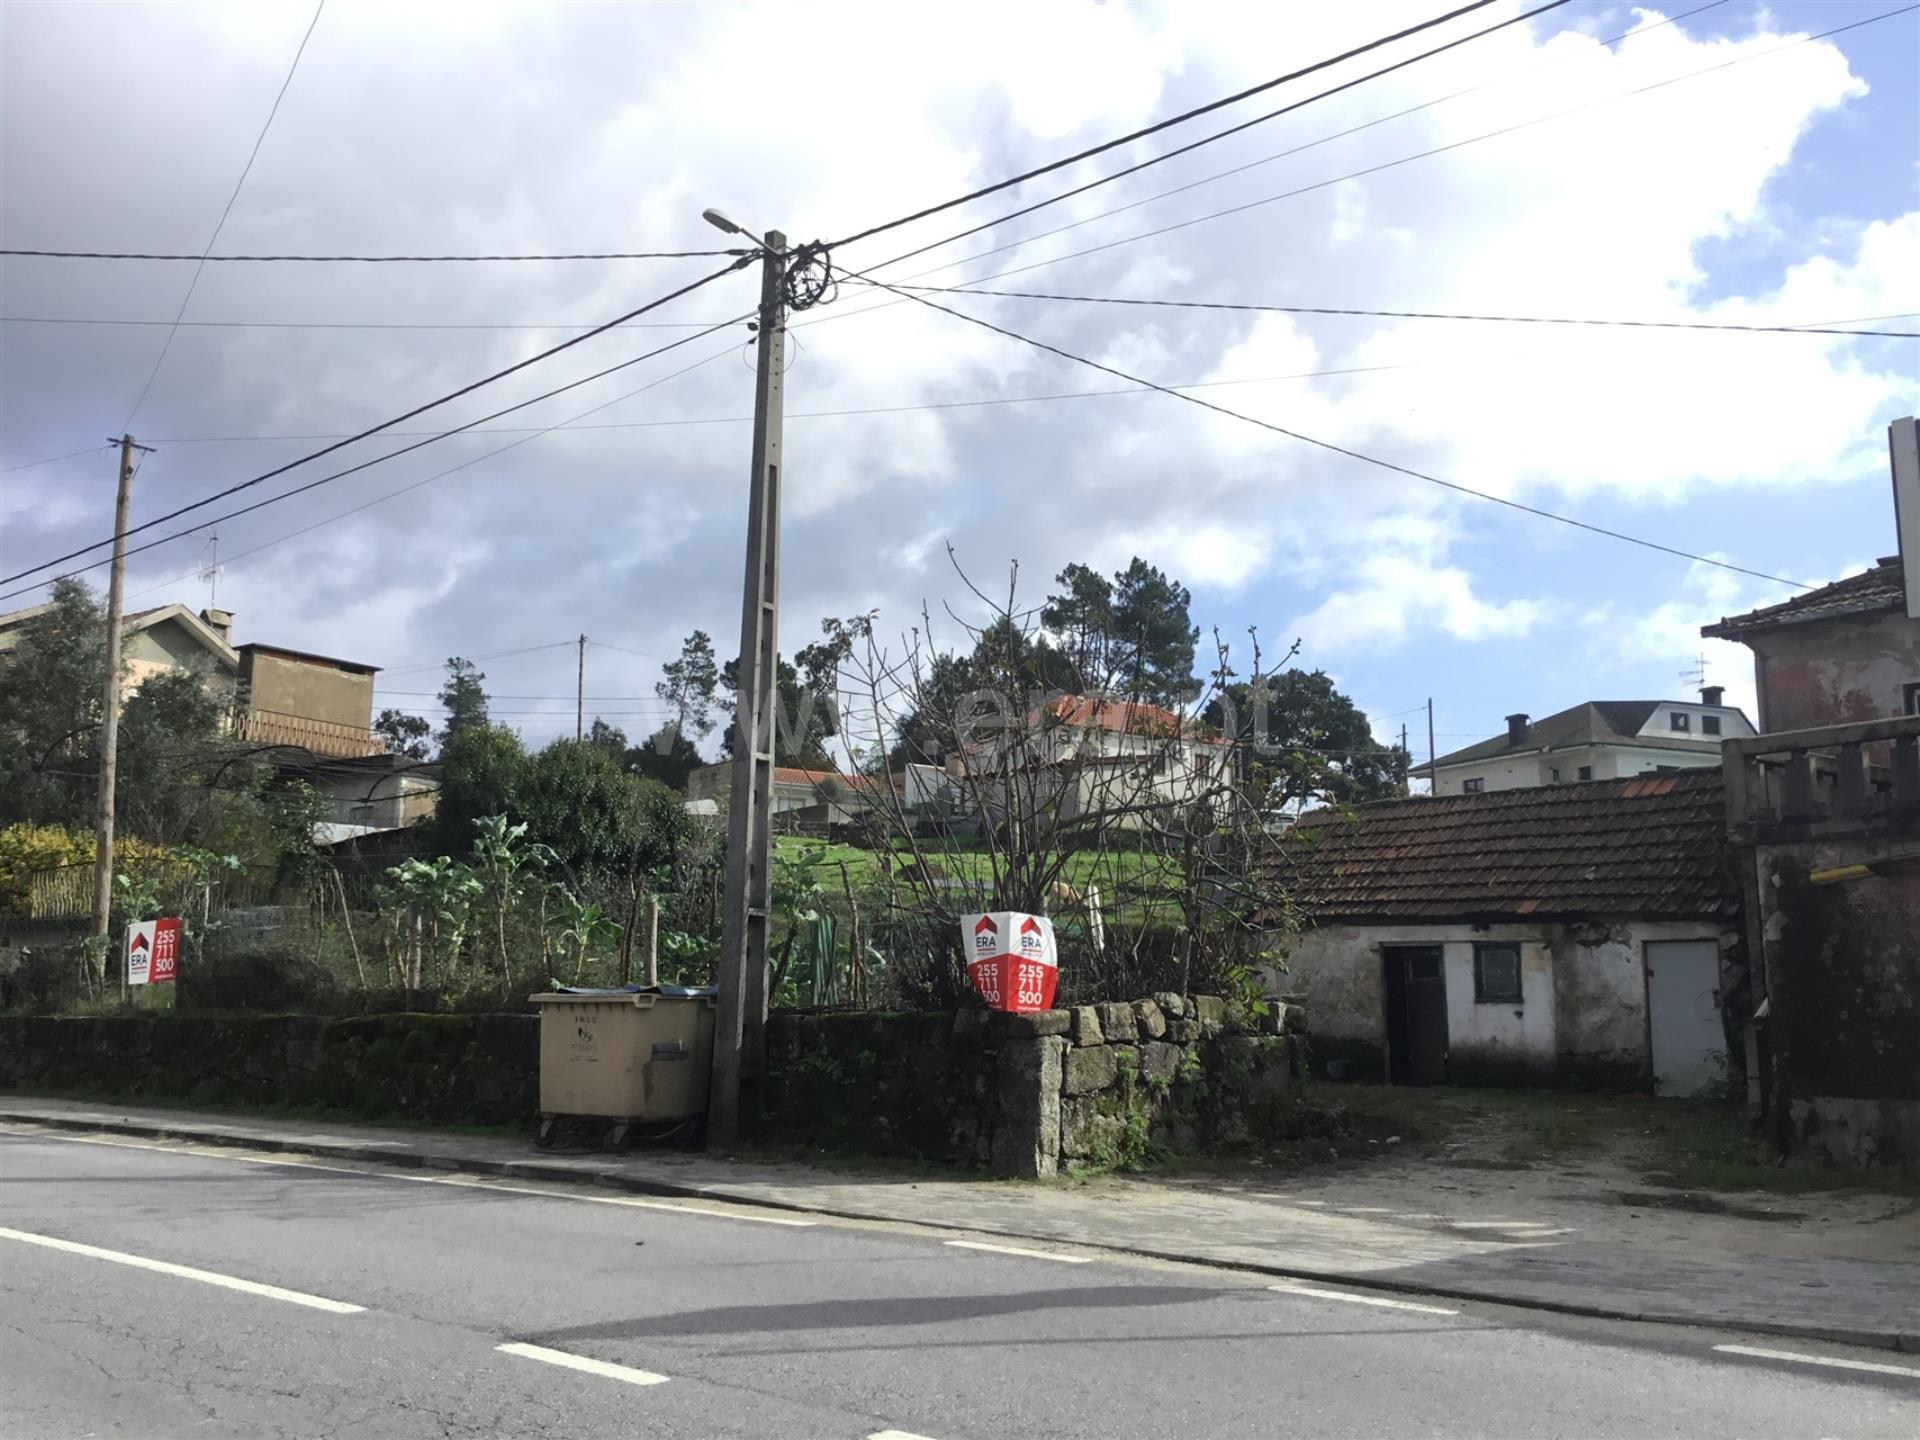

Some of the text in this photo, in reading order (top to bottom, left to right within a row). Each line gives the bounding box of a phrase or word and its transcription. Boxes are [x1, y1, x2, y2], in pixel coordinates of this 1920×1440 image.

[157, 929, 175, 944] 255
[976, 936, 996, 948] ERA
[1021, 936, 1042, 948] ERA
[156, 943, 174, 958] 711
[131, 953, 147, 966] ERA
[156, 957, 174, 972] 500
[977, 964, 998, 977] 255
[1018, 964, 1044, 978] 255
[978, 977, 998, 990] 711
[1018, 977, 1042, 992] 711
[1018, 991, 1042, 1005] 500
